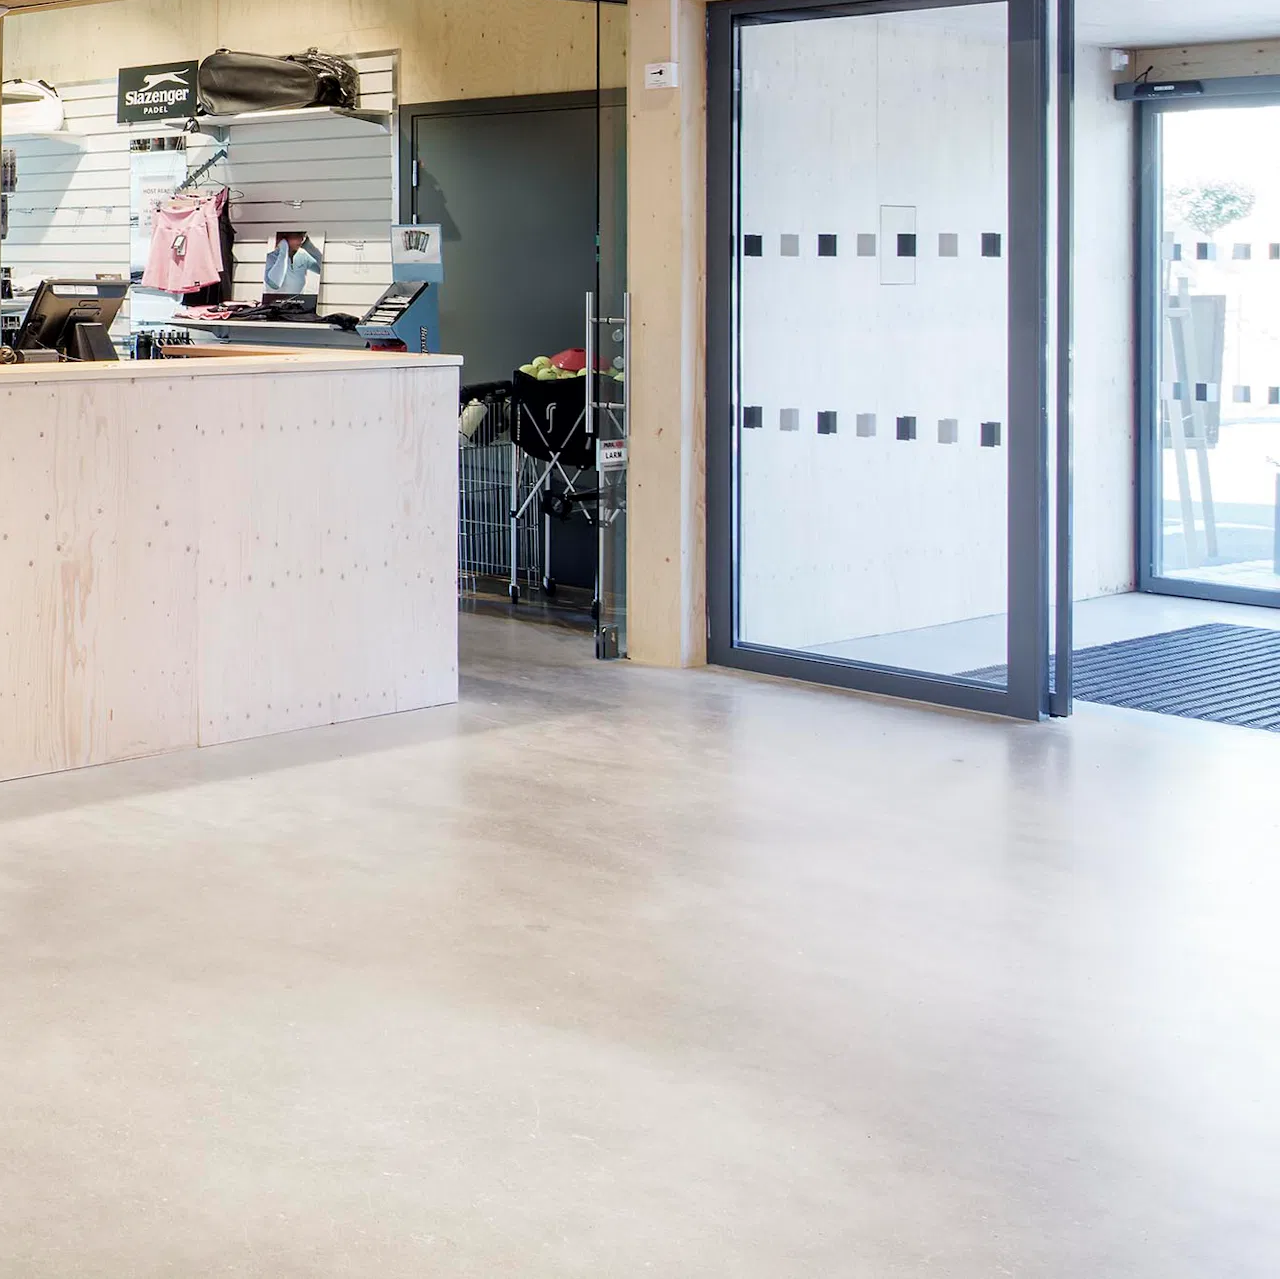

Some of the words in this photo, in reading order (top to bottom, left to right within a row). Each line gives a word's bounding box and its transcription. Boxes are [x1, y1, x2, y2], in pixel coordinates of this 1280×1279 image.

[125, 88, 189, 106] Slazenger
[143, 106, 168, 115] PADEL
[605, 451, 622, 459] LARM
